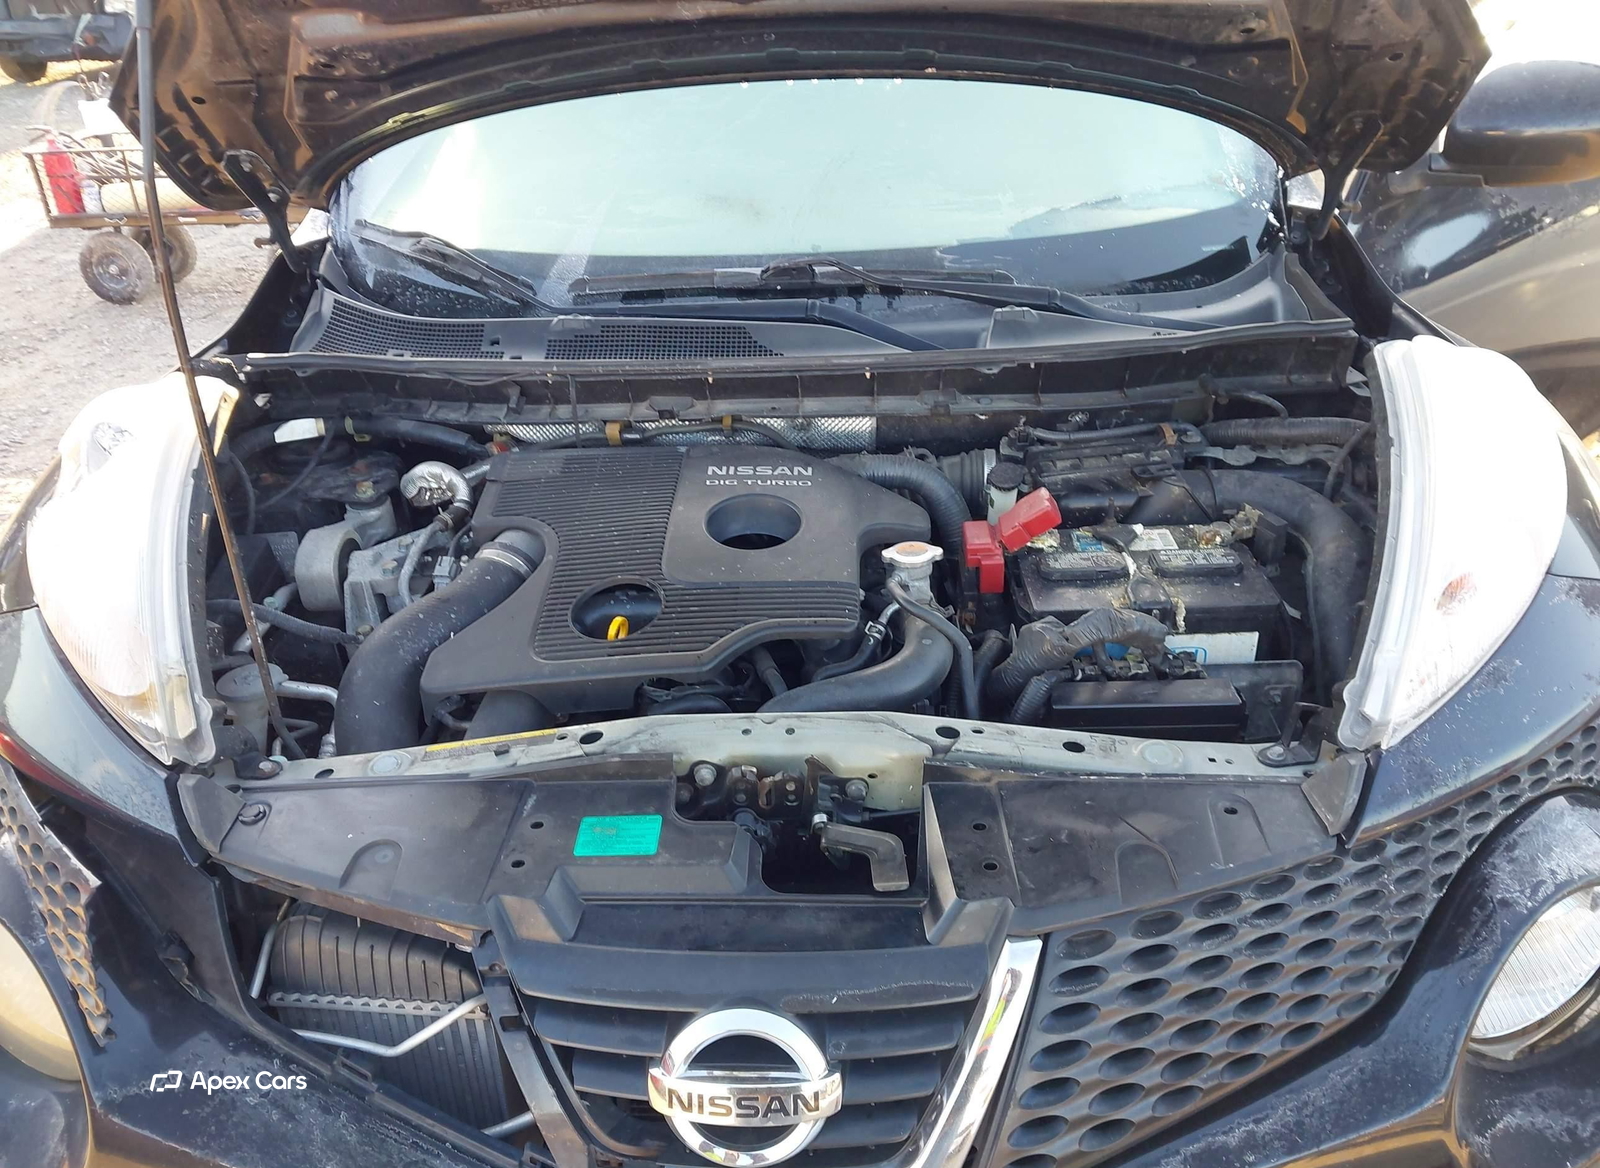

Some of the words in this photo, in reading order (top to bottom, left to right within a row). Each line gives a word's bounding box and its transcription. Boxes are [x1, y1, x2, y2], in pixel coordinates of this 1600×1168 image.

[707, 465, 812, 476] NISSAN
[743, 479, 812, 487] TURBO
[667, 1087, 821, 1119] NISSAN
